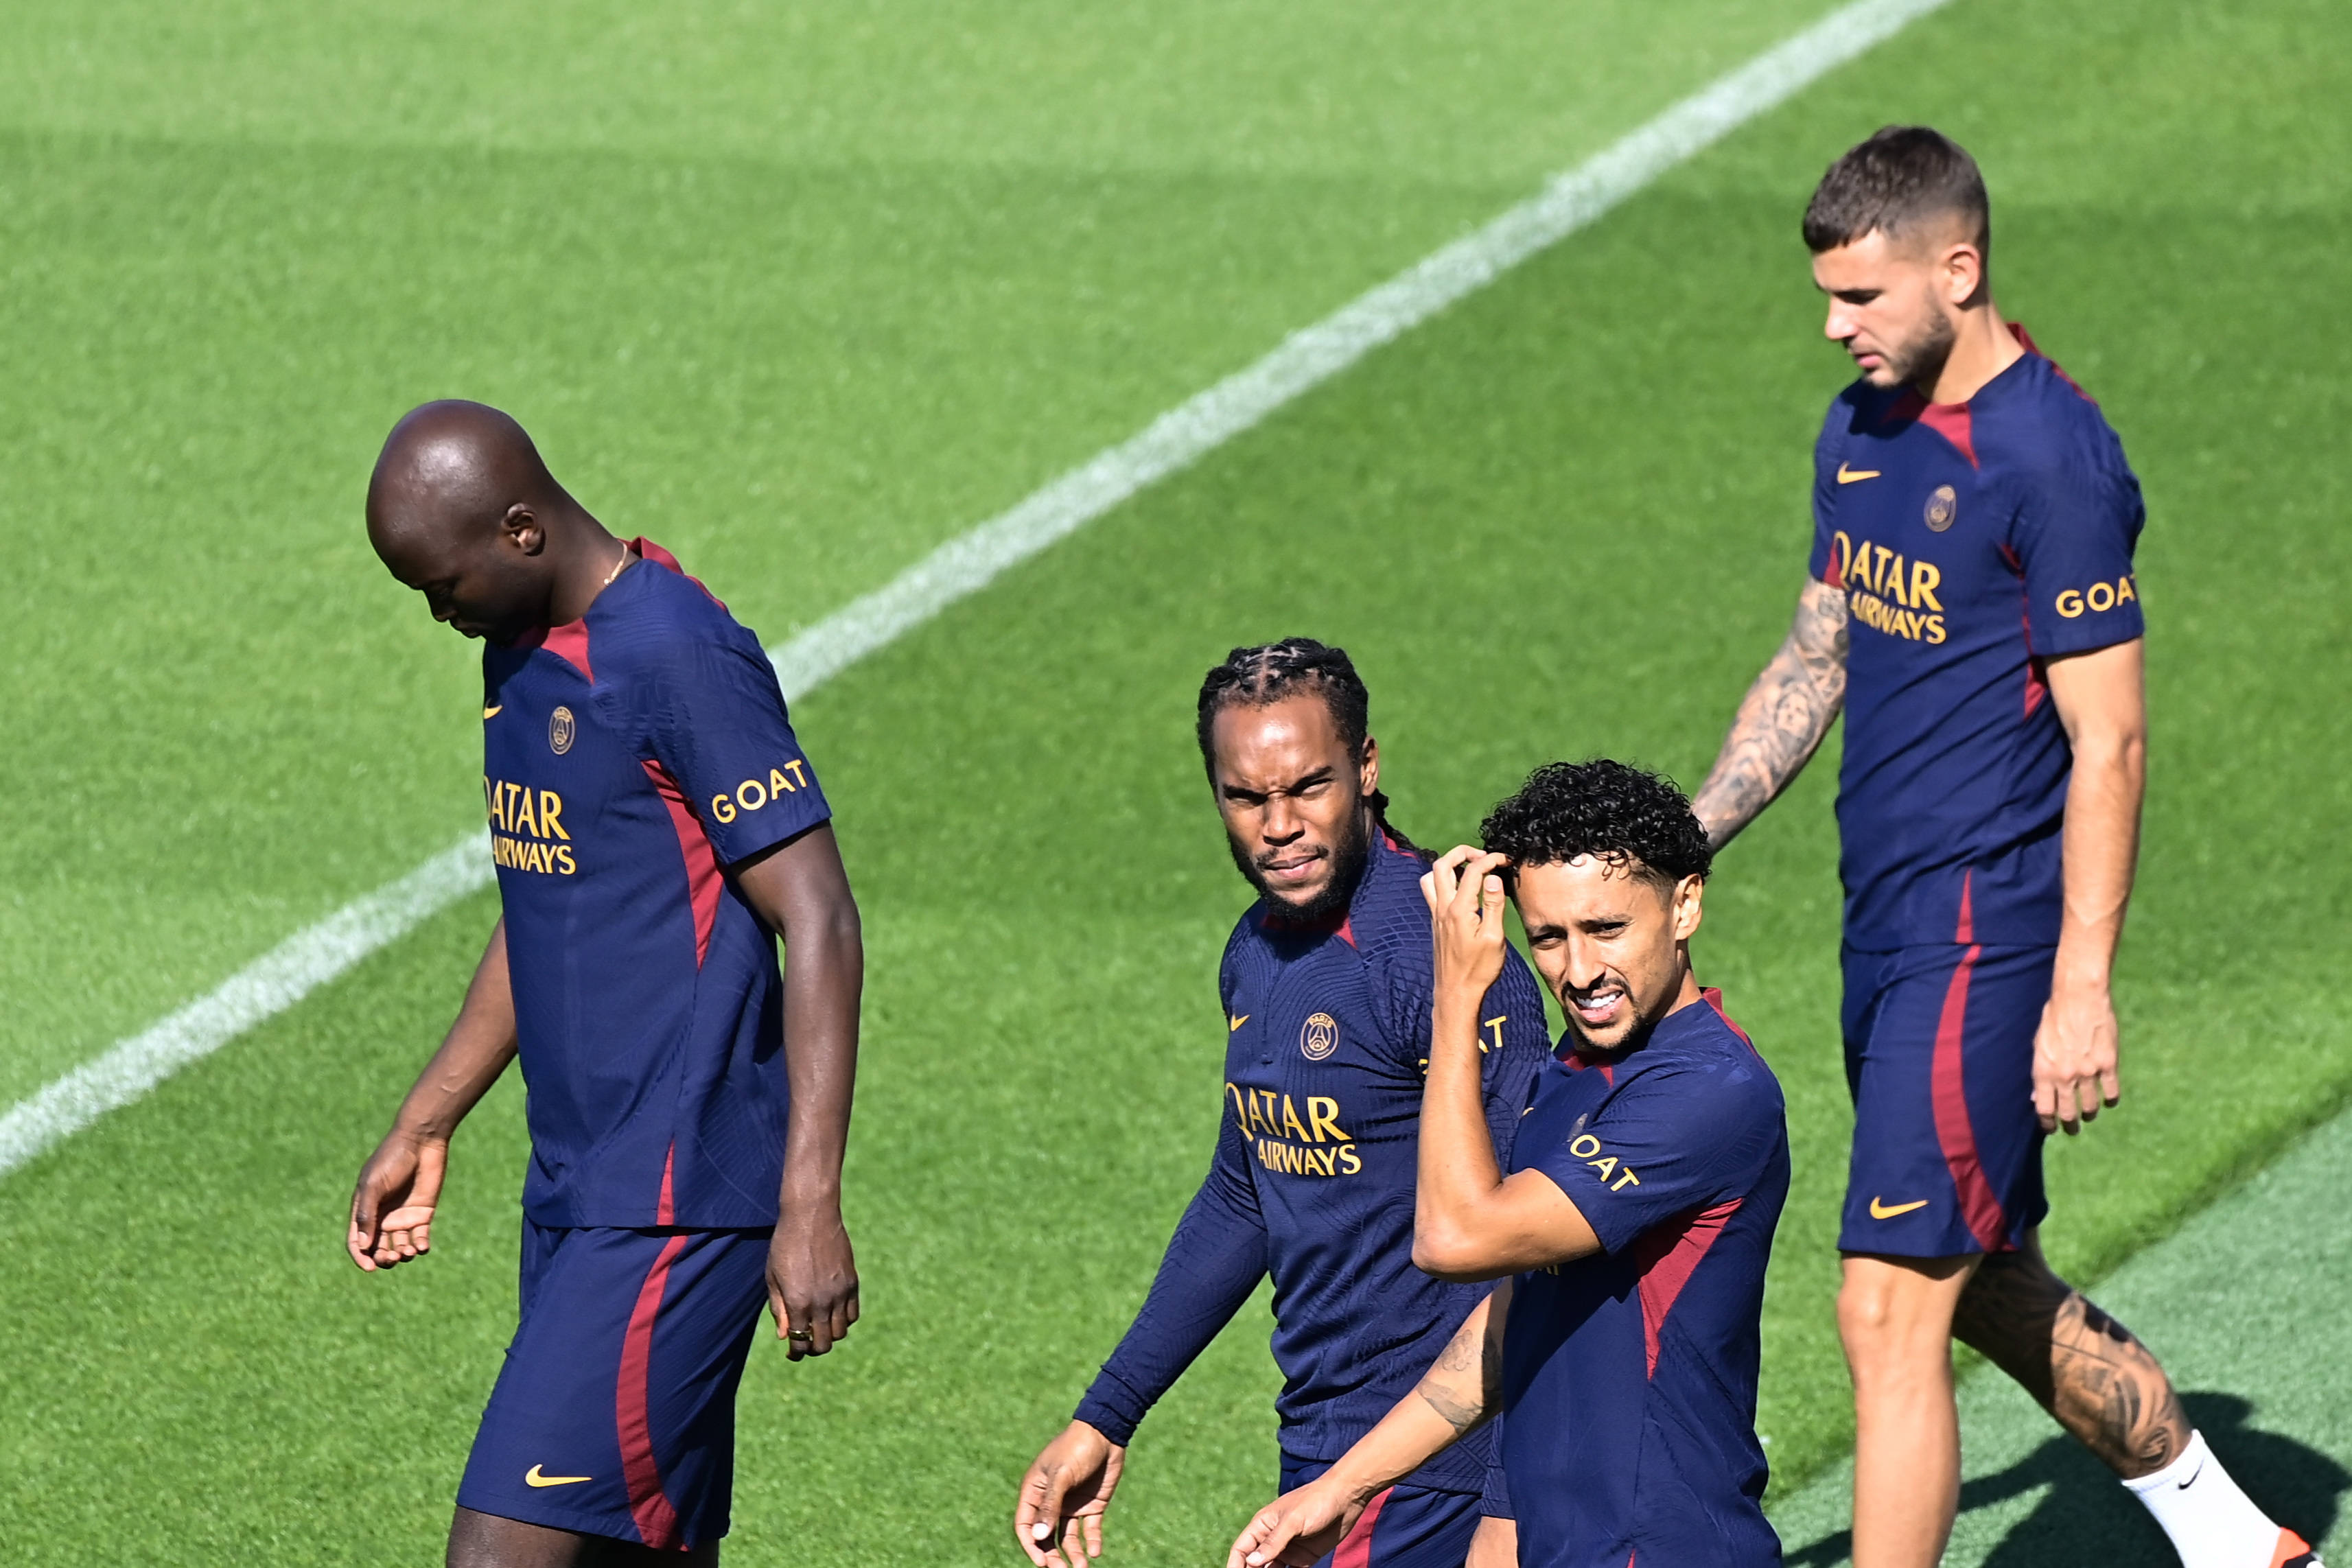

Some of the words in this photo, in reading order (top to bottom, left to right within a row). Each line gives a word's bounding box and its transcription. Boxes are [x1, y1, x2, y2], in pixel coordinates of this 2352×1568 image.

[1834, 530, 1944, 611] QATAR
[2056, 574, 2136, 618] GOA
[1850, 589, 1947, 644] AIRWAYS
[712, 758, 808, 823] GOAT
[1225, 1081, 1353, 1143] QATAR
[1258, 1138, 1362, 1175] AIRWAYS
[1570, 1134, 1640, 1192] OAT
